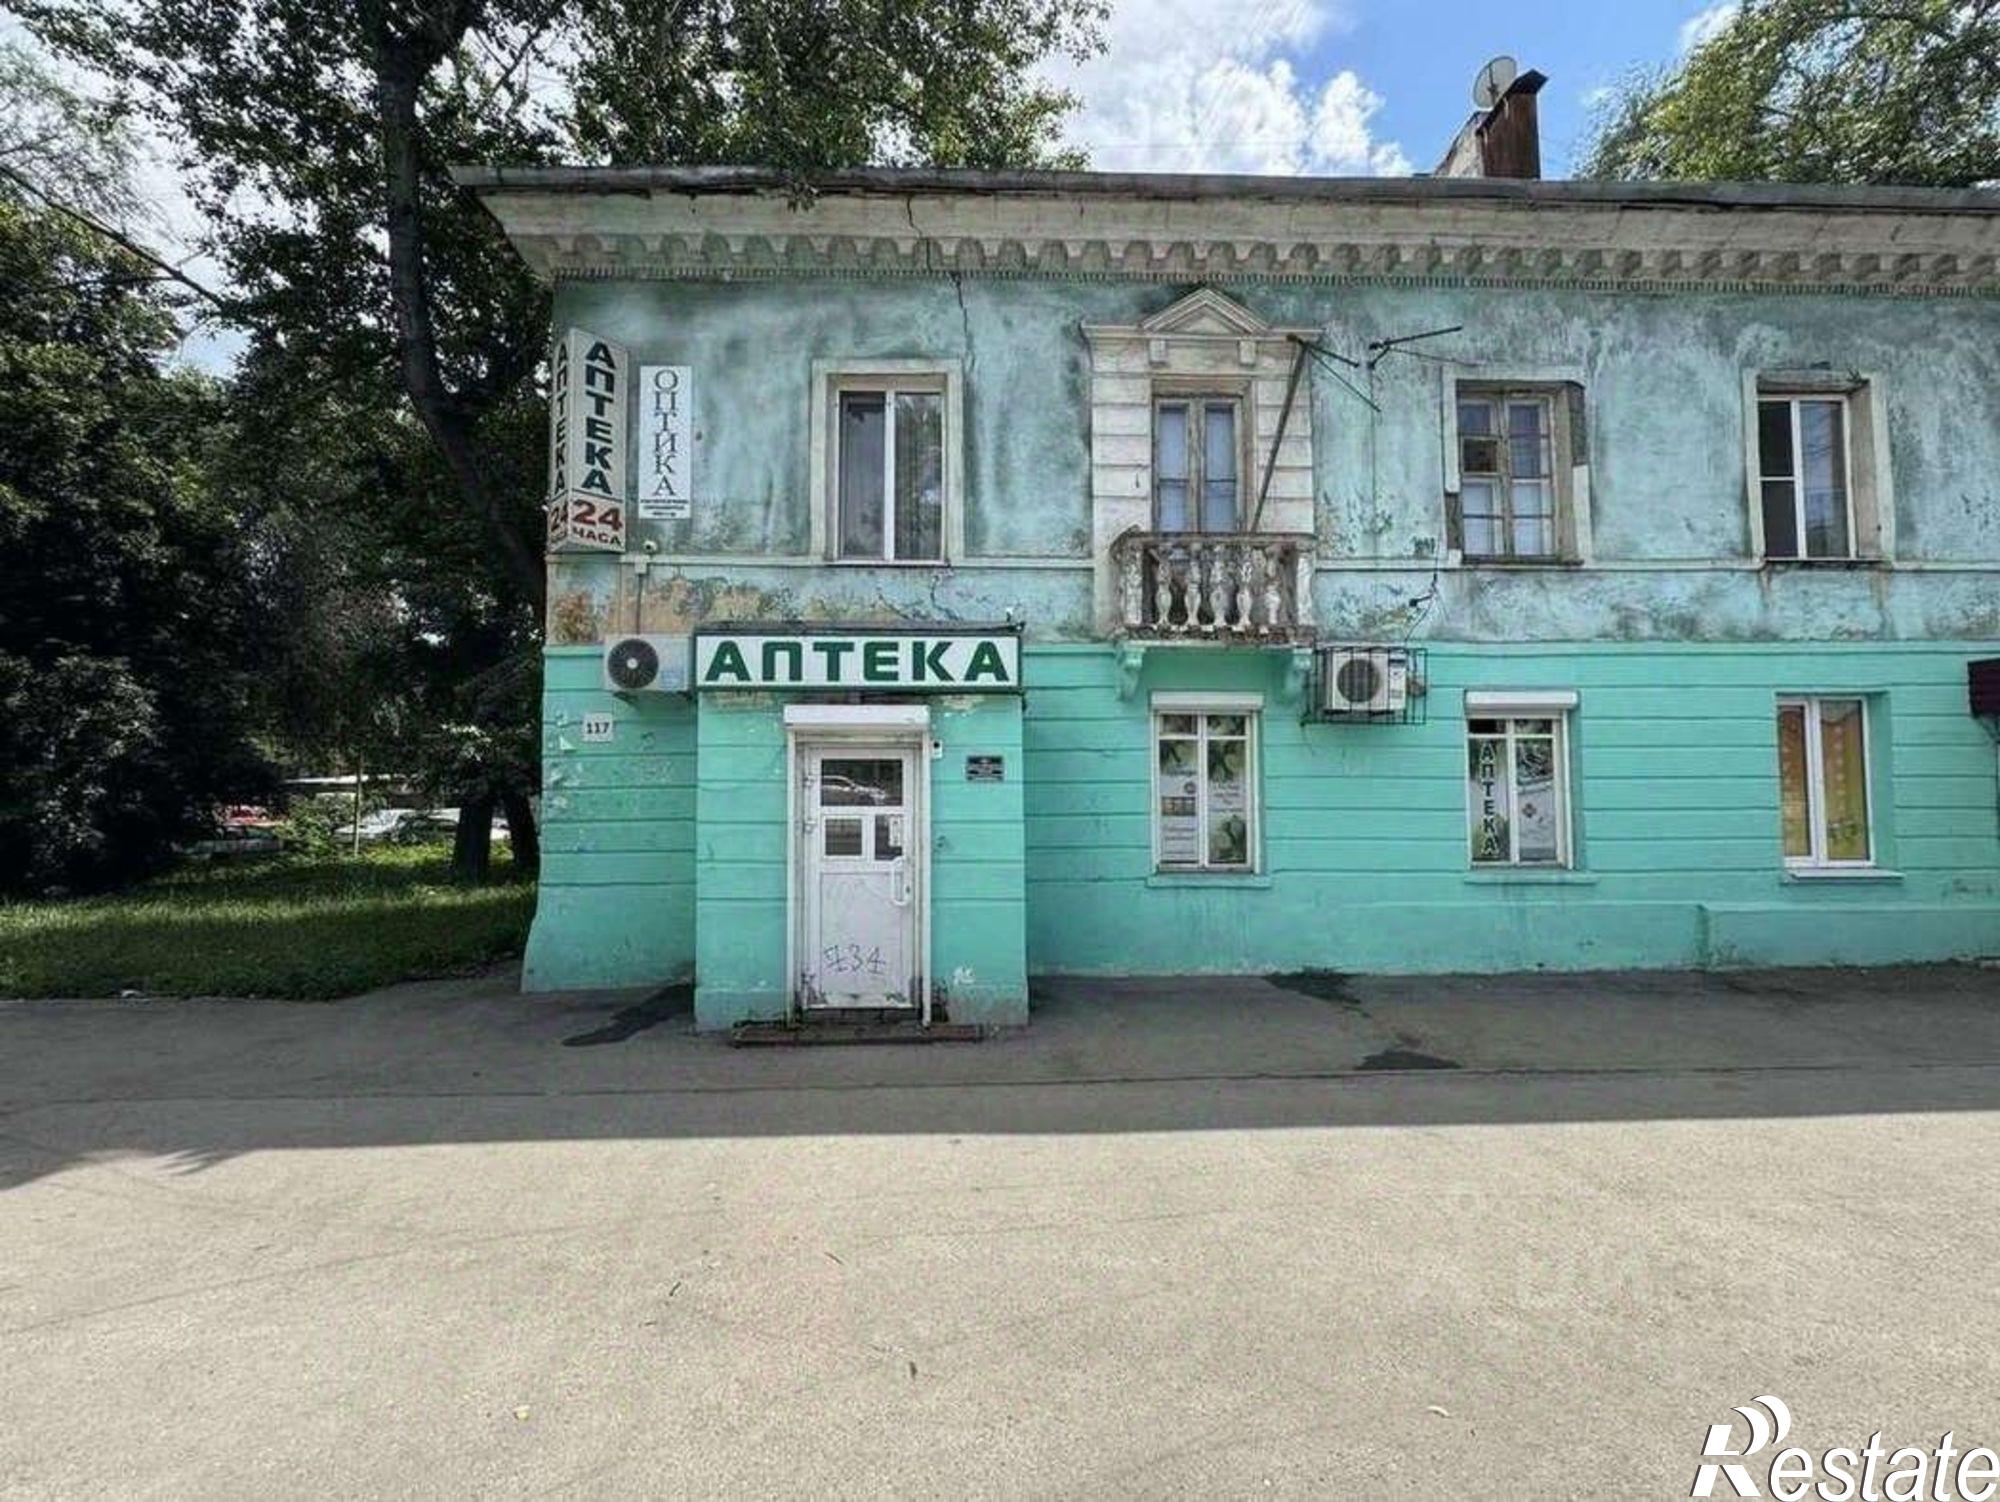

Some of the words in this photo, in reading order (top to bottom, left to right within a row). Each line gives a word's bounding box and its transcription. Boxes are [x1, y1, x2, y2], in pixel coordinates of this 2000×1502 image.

[553, 342, 568, 495] АПТЕКА
[581, 341, 617, 495] АПТЕКА
[653, 369, 679, 496] ОПТИКА
[572, 499, 623, 531] 24
[573, 527, 622, 546] ЧАСА
[704, 640, 1010, 682] АПТЕКА
[586, 721, 610, 735] 117
[1479, 738, 1500, 857] АПТЕКА
